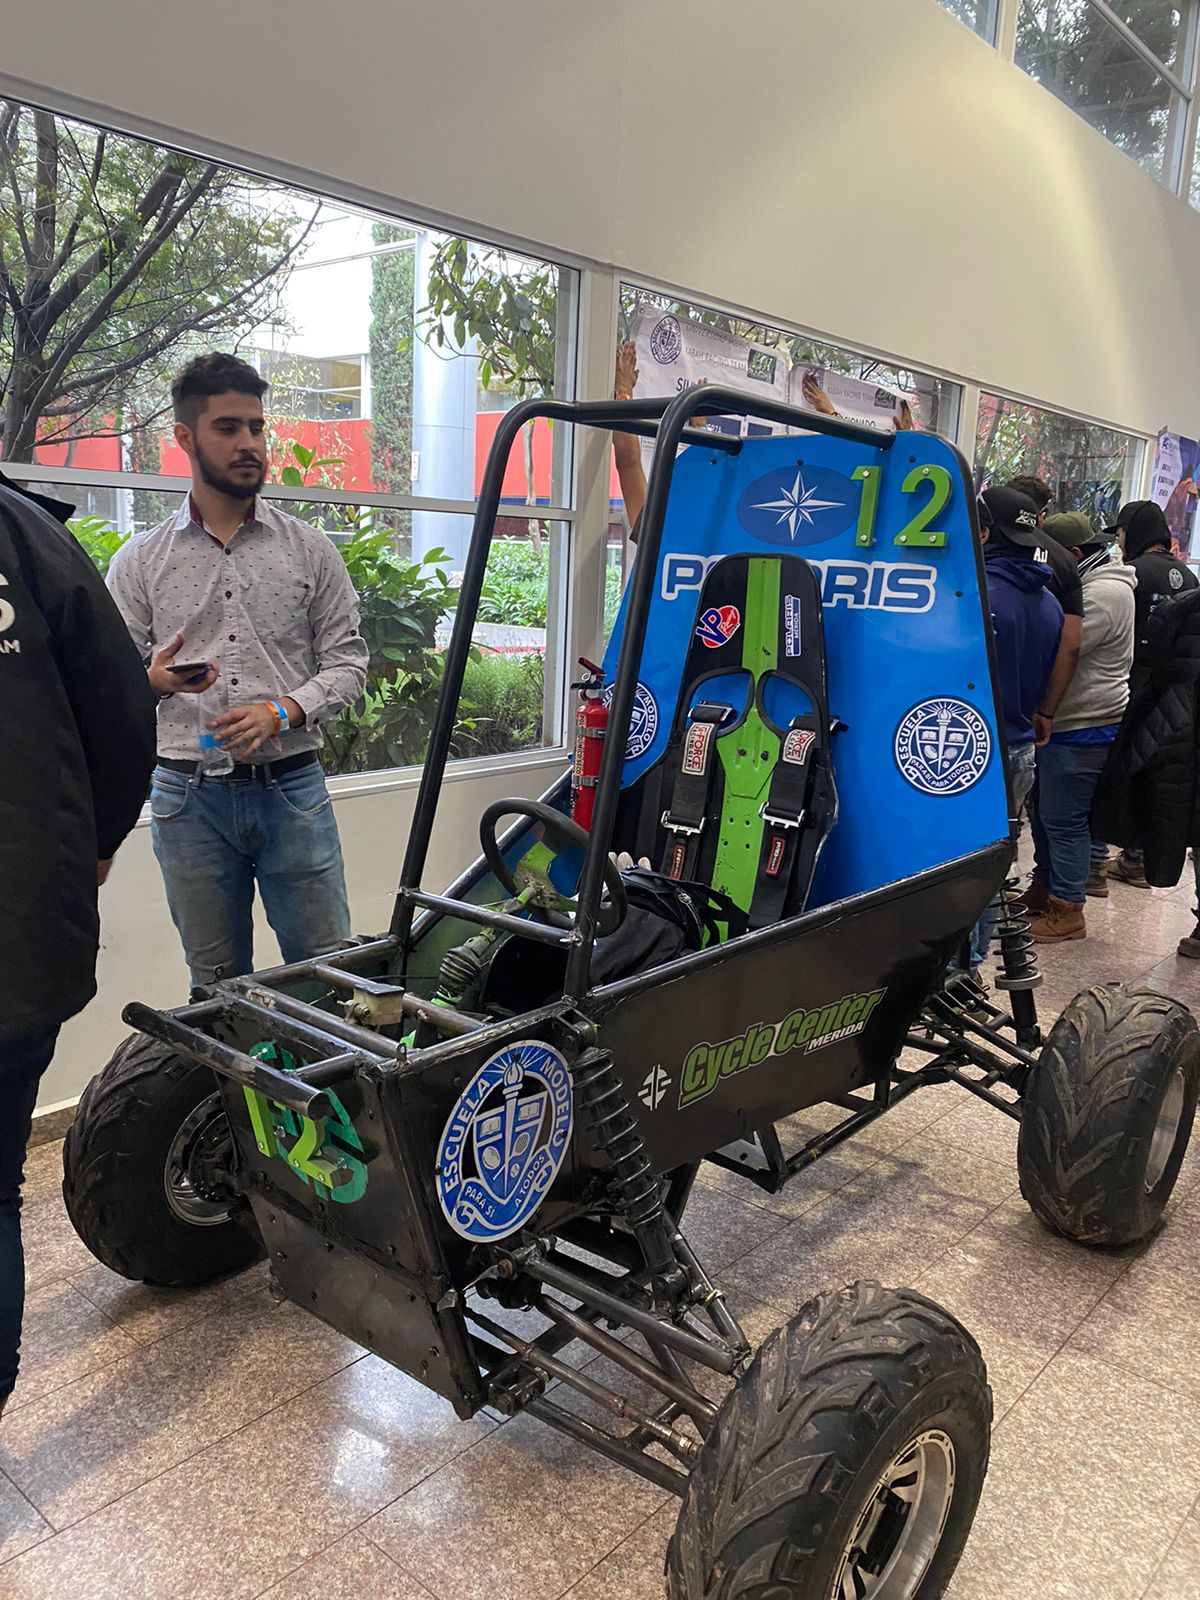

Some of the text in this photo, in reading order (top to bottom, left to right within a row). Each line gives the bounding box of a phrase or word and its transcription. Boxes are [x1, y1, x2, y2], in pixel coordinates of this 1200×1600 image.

[850, 464, 954, 548] 12
[661, 553, 937, 613] PRIS
[695, 608, 729, 645] VP
[785, 594, 793, 656] POLARIS
[643, 696, 655, 742] MODELO
[791, 731, 810, 758] ORCE
[899, 709, 987, 765] ESCUELA MODELO
[691, 727, 707, 769] G-FORCE
[910, 759, 927, 775] PARA
[948, 764, 970, 781] TODOS
[681, 991, 885, 1104] Cycle Center
[808, 1021, 865, 1051] MERIDA
[443, 1056, 569, 1193] ESCUELA MODELO
[465, 1186, 486, 1209] PARA
[519, 1154, 545, 1195] TODOS
